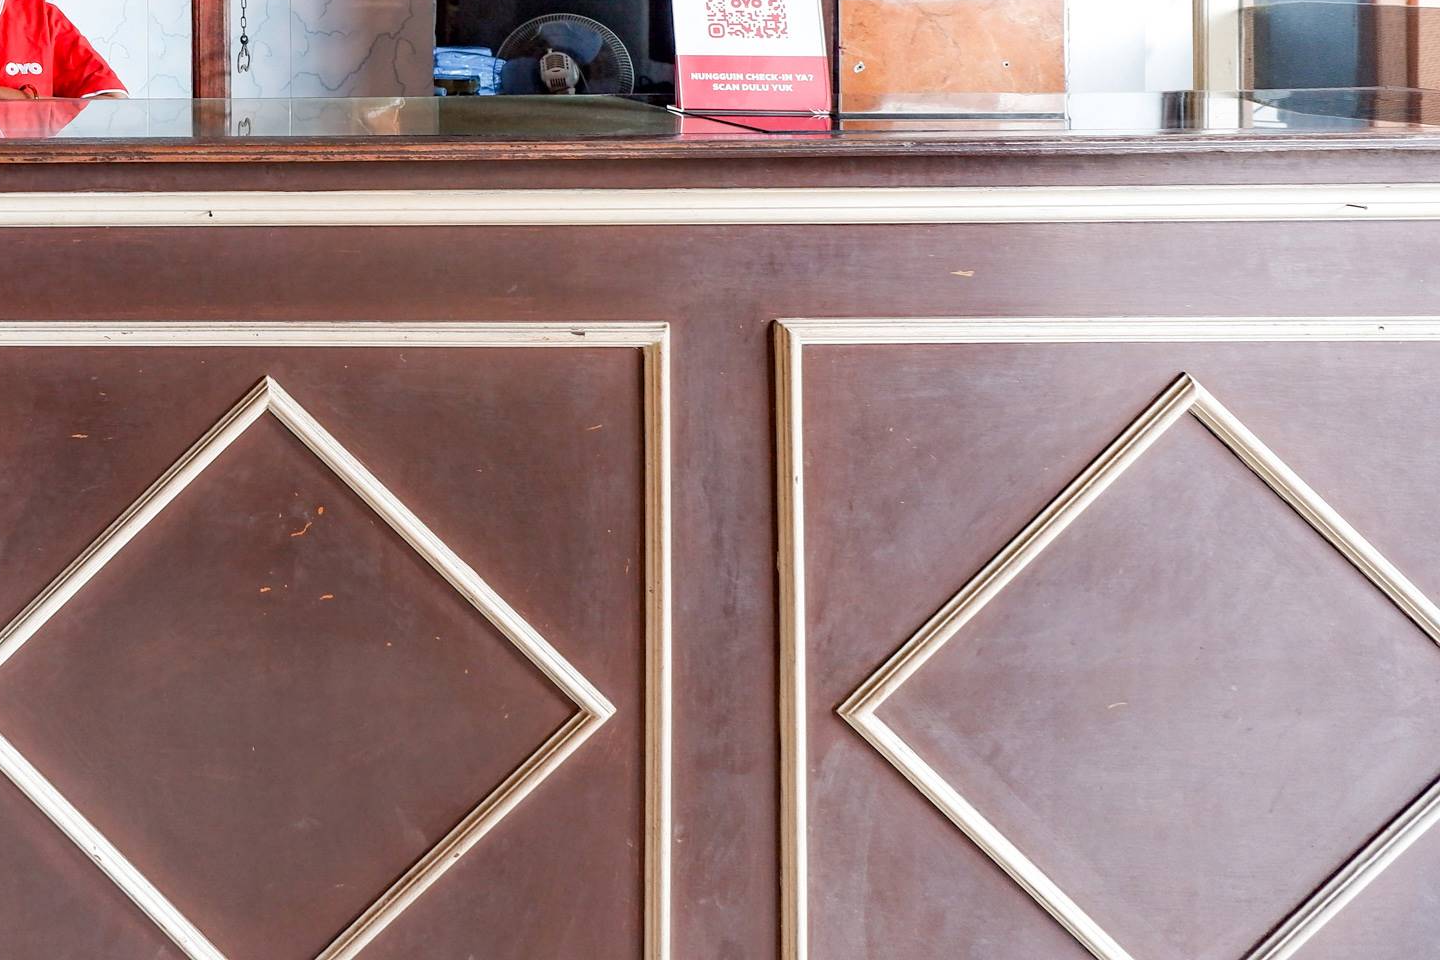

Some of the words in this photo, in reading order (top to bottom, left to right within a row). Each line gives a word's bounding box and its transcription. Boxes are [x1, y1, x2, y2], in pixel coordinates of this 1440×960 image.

[5, 62, 43, 76] OYO
[690, 72, 743, 81] NUNGGUIN
[745, 73, 793, 81] CHECK-IN
[795, 73, 814, 81] YA?
[712, 83, 740, 91] SCAN
[770, 84, 793, 92] YUK
